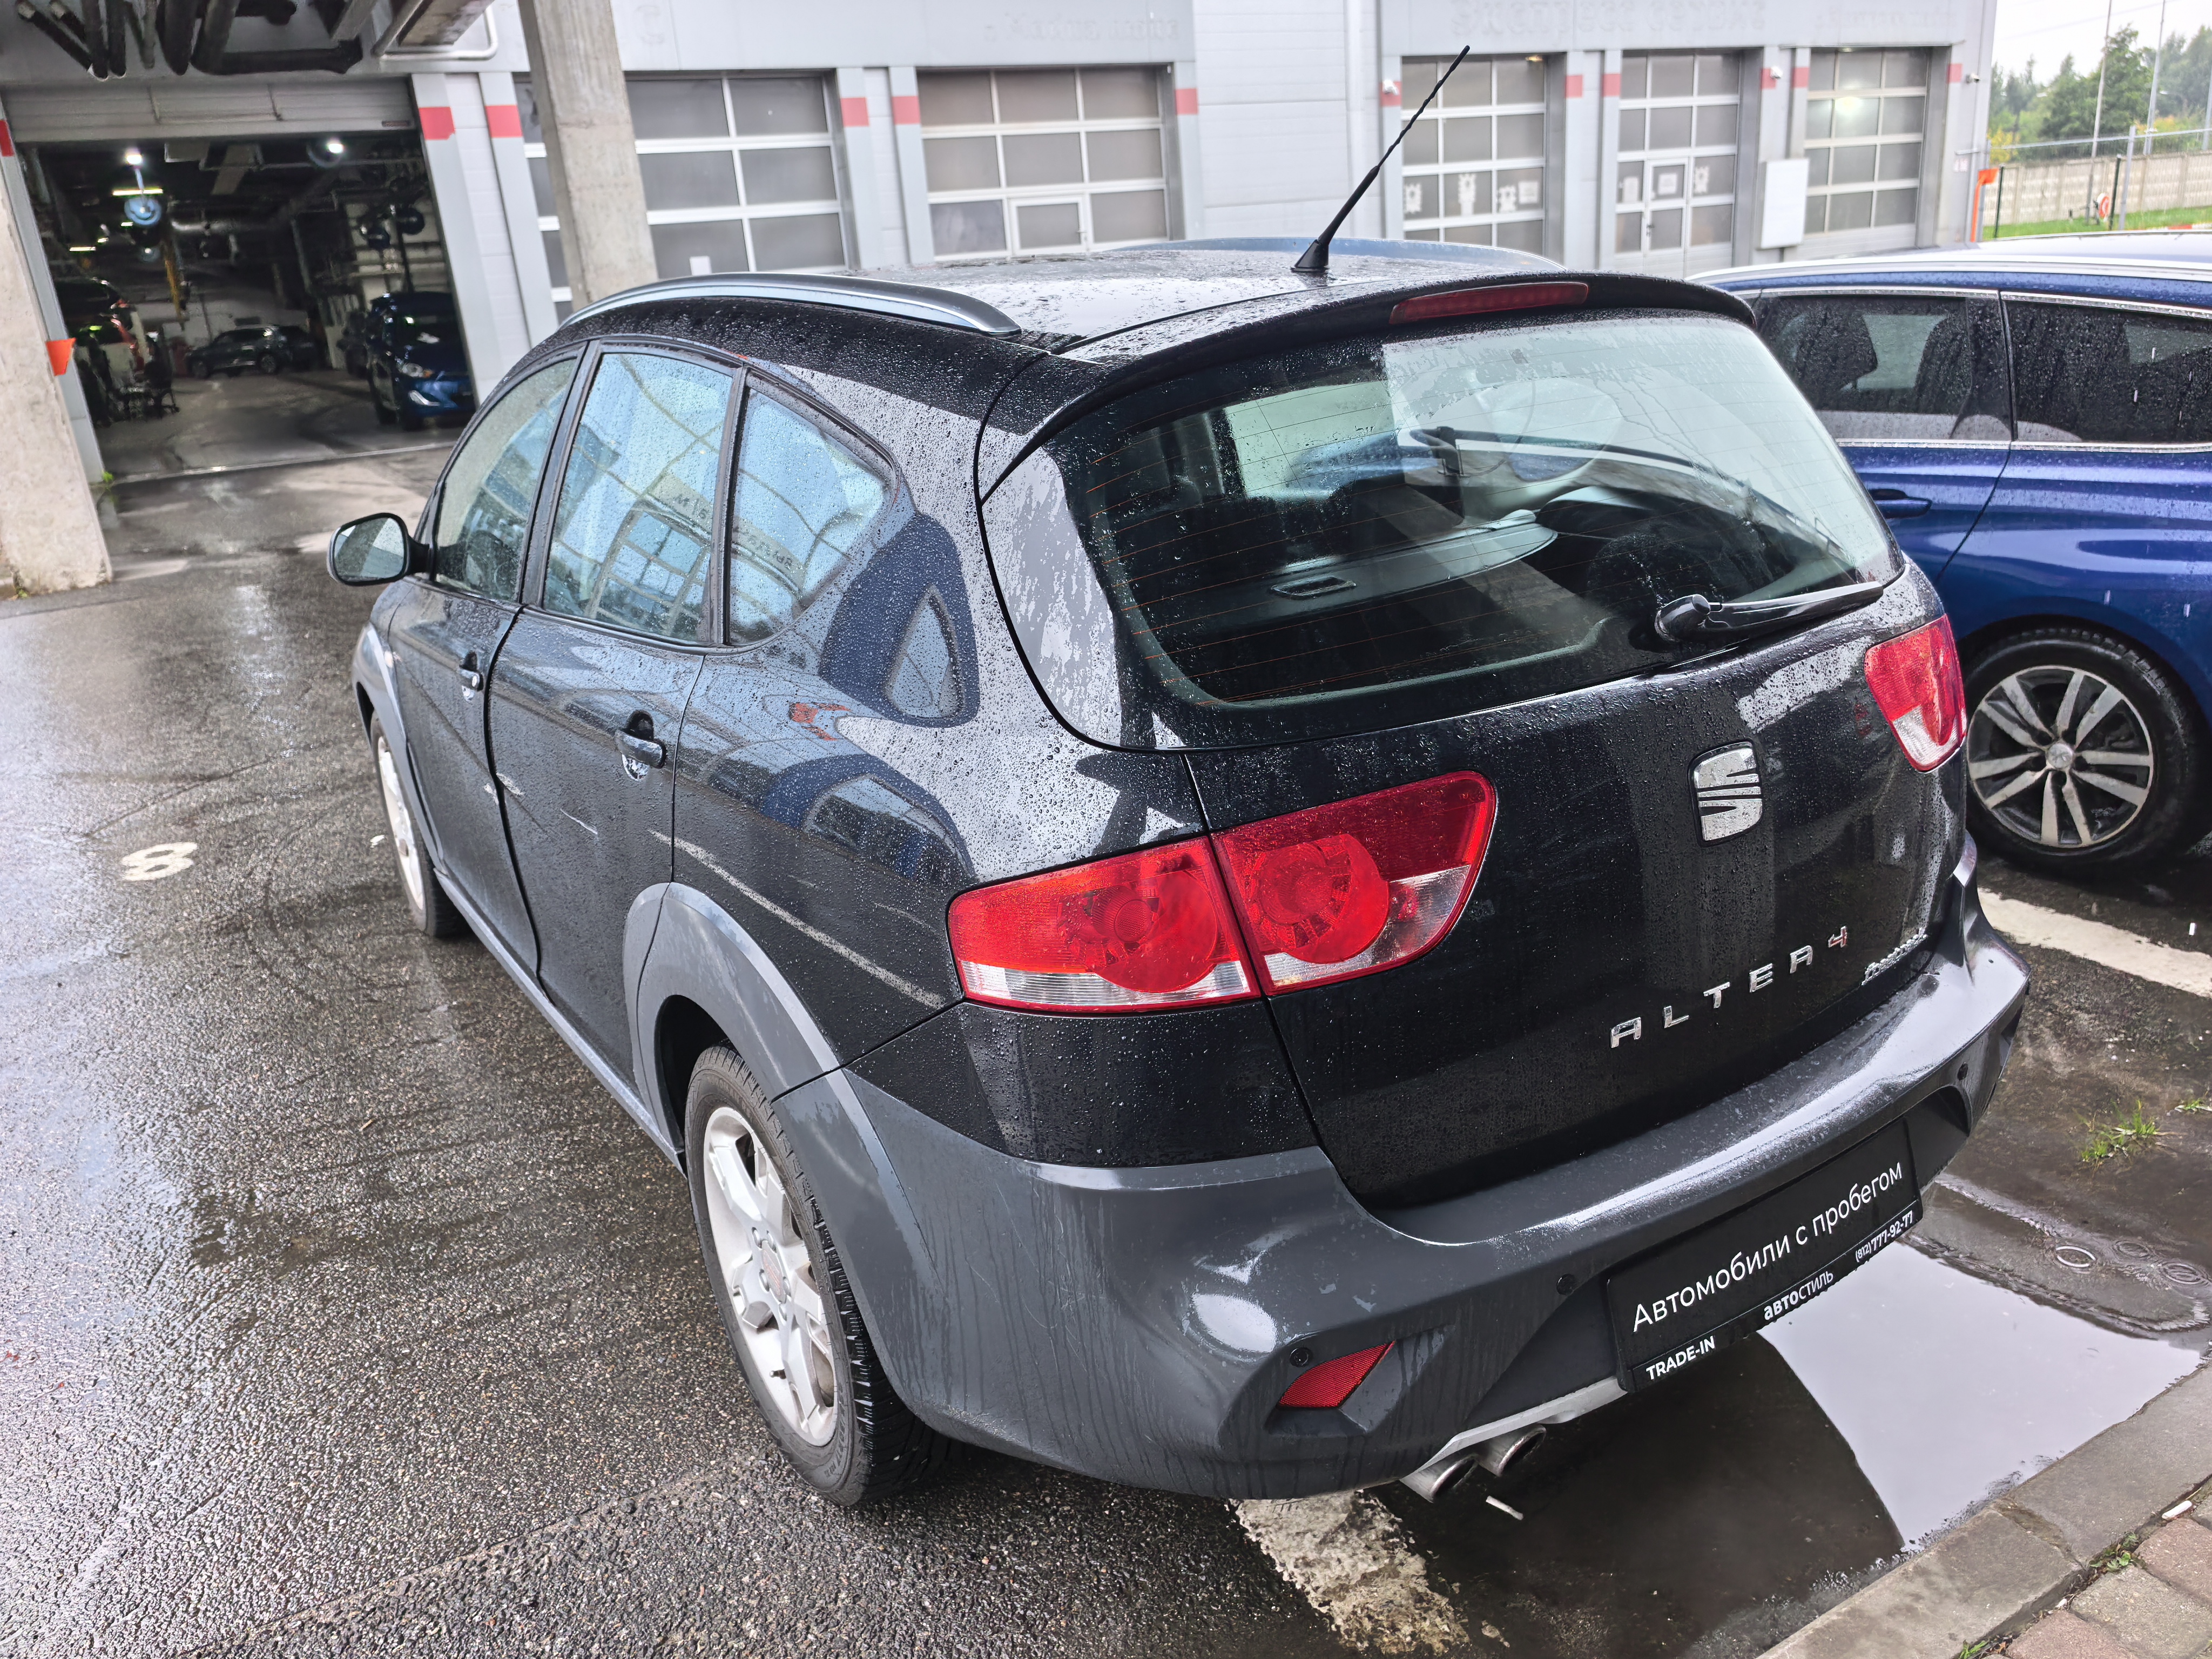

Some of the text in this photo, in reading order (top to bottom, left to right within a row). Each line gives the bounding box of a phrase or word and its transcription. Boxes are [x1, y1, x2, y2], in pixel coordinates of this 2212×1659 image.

[1633, 1162, 1903, 1333] Автомобили с пробегом
[1645, 1335, 1715, 1380] TRADE-IN
